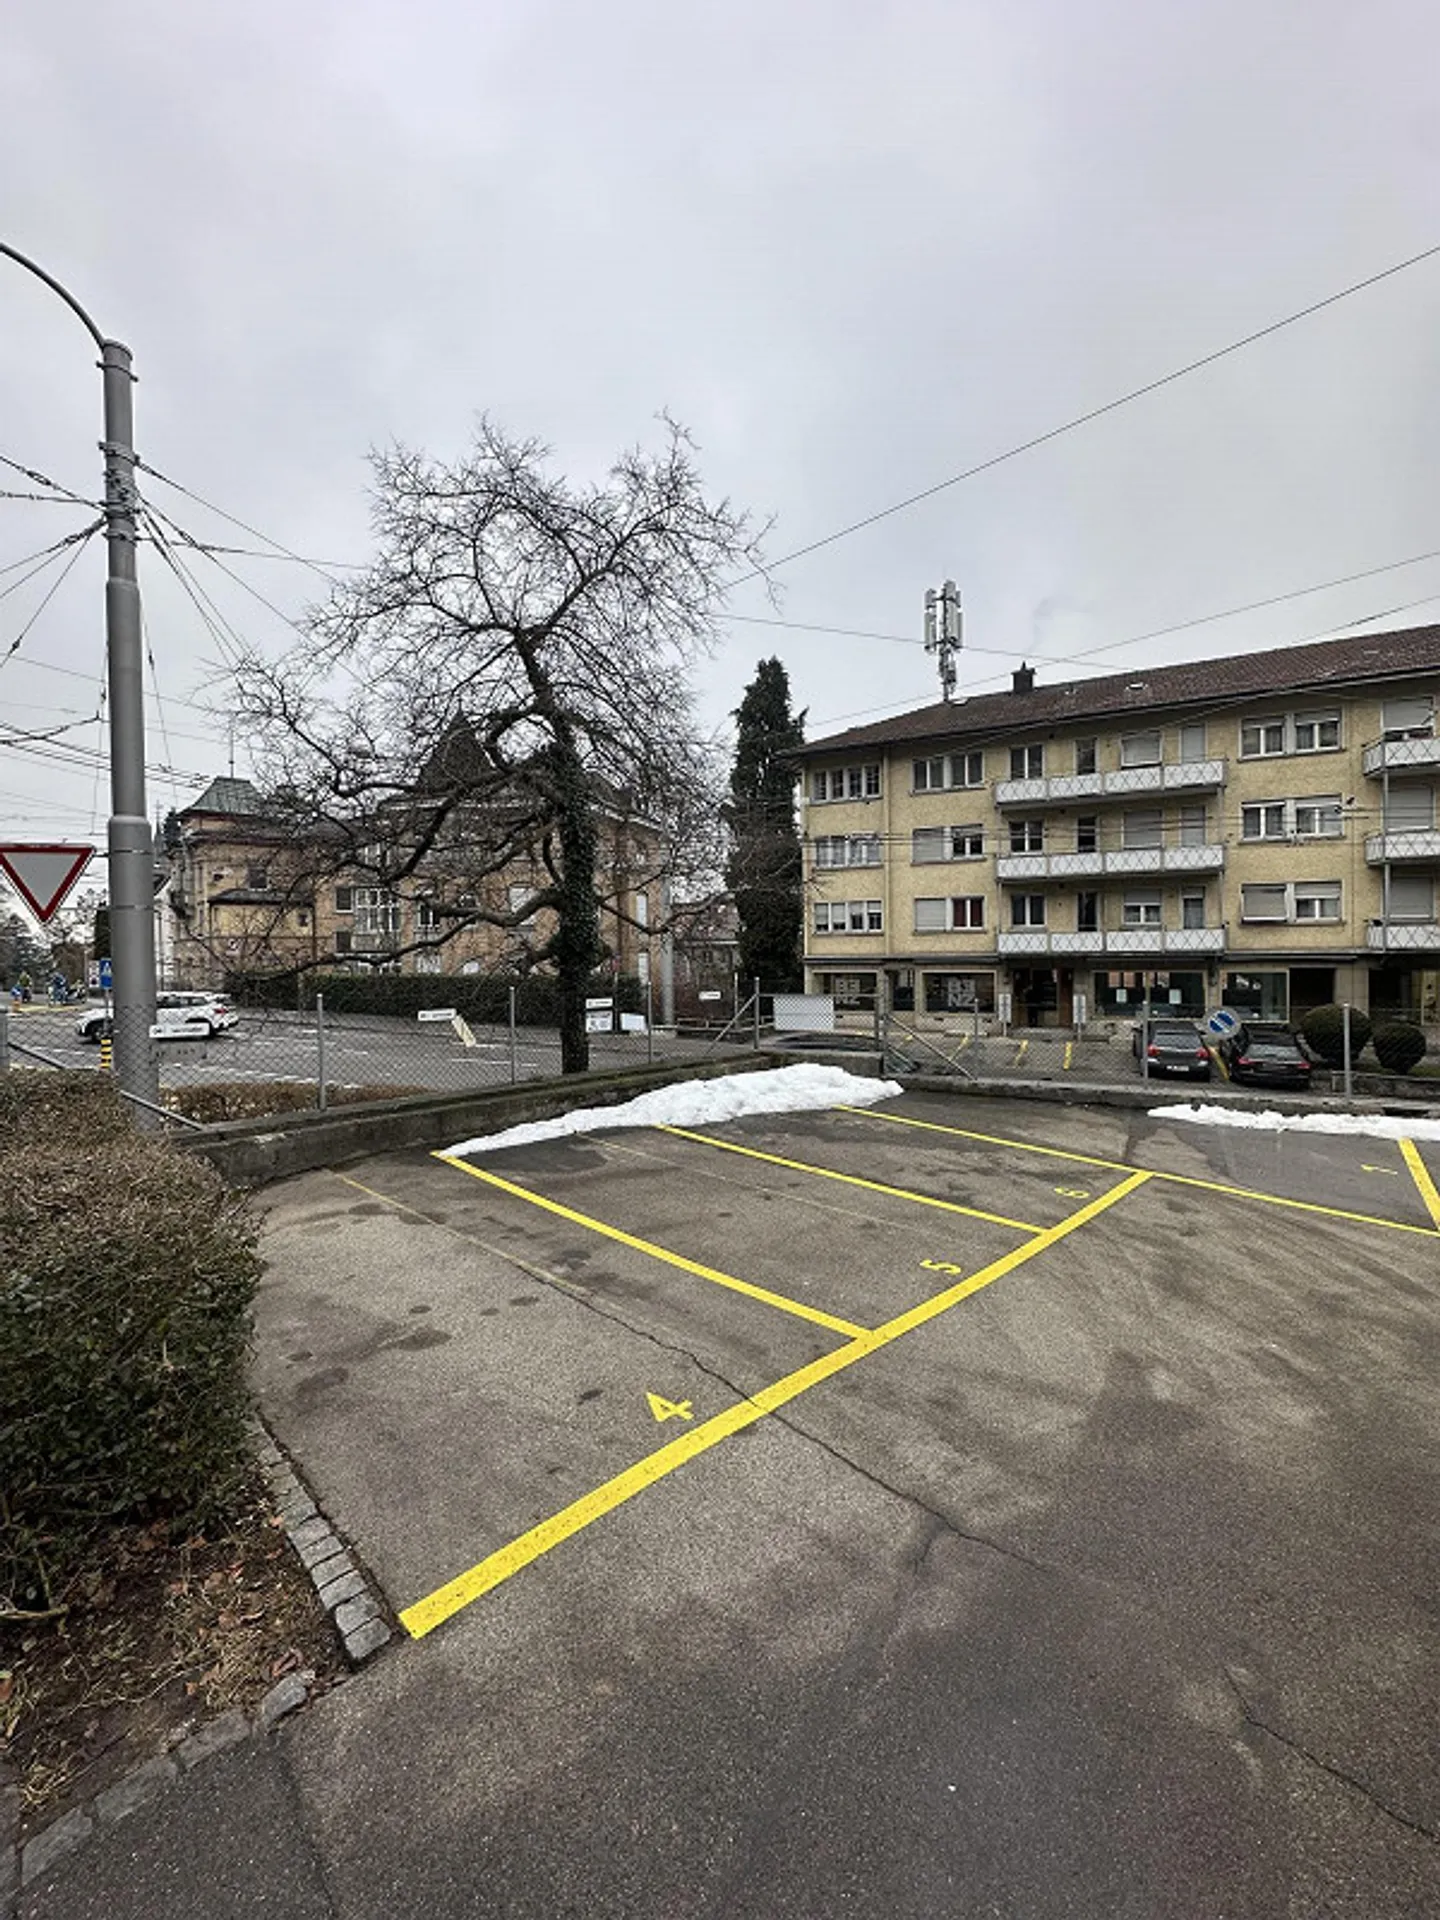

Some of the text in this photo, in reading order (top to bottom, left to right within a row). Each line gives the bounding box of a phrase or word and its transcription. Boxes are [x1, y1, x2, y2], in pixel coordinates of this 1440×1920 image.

[1054, 1187, 1090, 1199] 6
[919, 1257, 961, 1275] 5
[645, 1391, 695, 1423] 4
